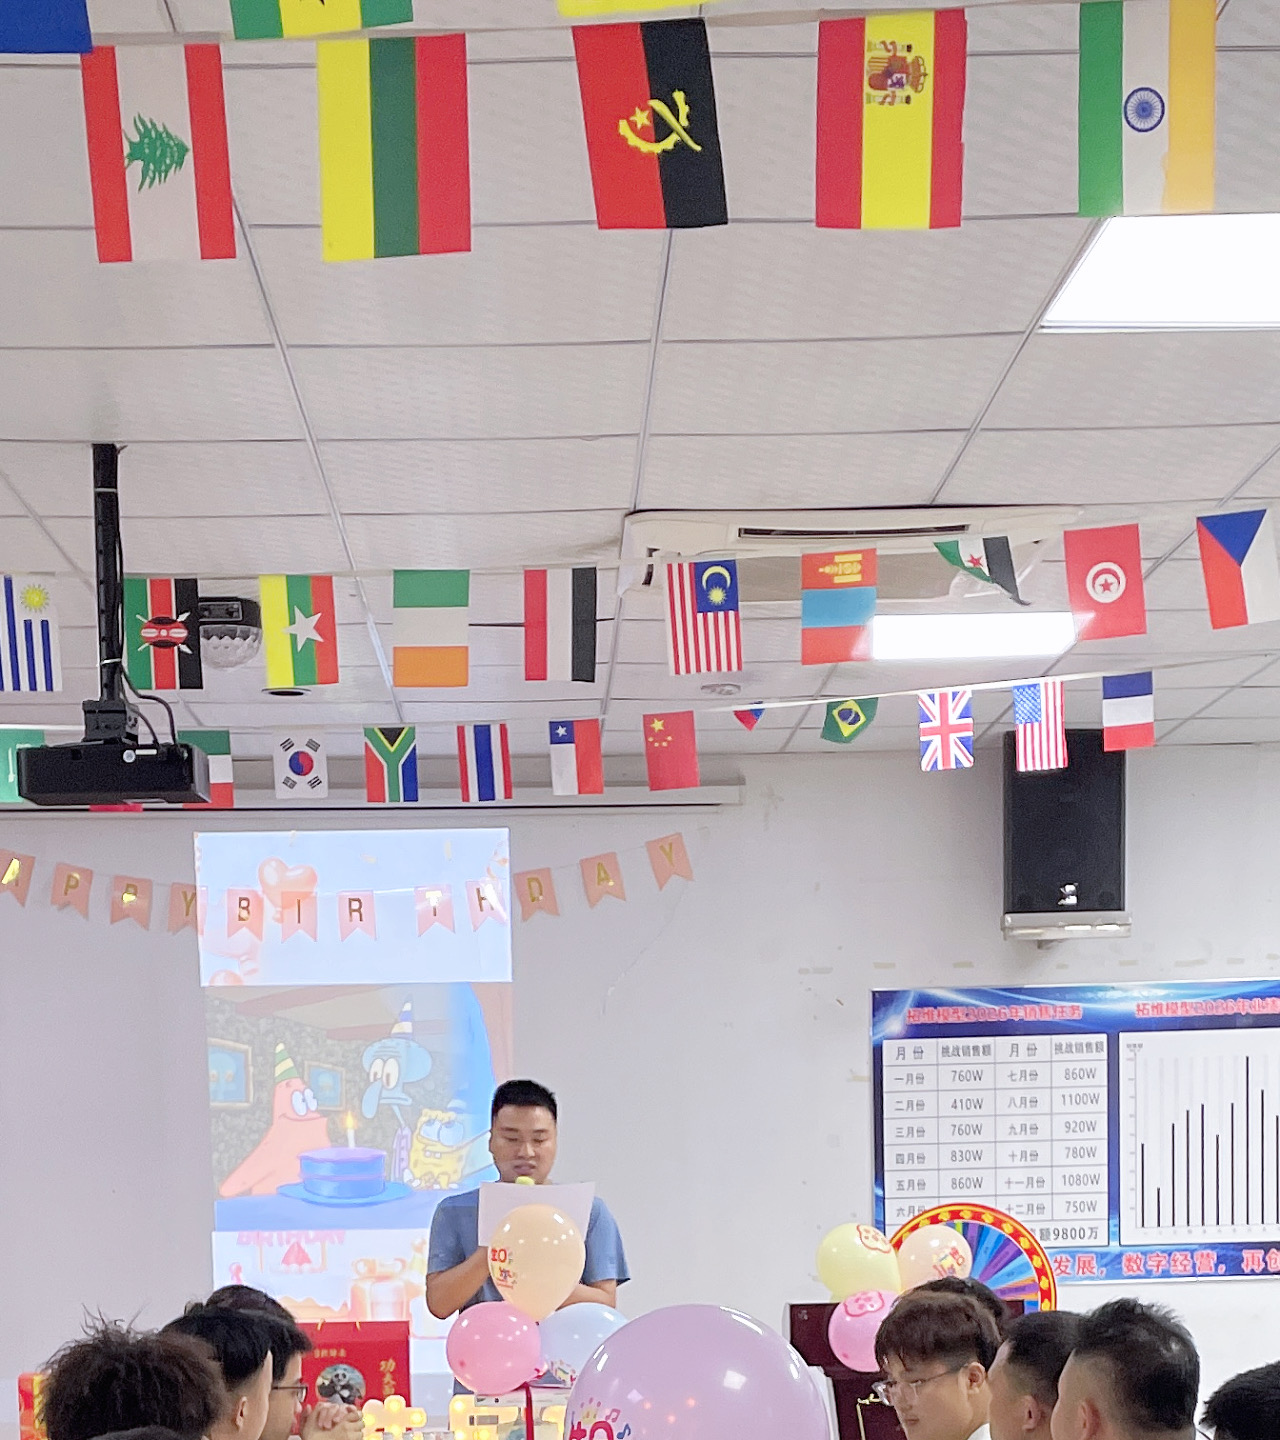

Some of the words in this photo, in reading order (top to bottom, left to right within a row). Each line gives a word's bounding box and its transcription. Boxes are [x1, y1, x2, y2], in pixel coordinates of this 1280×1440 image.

[894, 1073, 925, 1086] 一月份
[951, 1069, 984, 1082] 760W
[1007, 1069, 1039, 1082] 七月份
[1064, 1068, 1097, 1081] 860W
[894, 1099, 926, 1112] 二月份
[951, 1097, 984, 1110] 410W
[1007, 1096, 1039, 1109] 八月份
[1061, 1093, 1100, 1106] 1100W
[895, 1126, 926, 1138] 三月份
[950, 1123, 983, 1136] 760W
[1008, 1123, 1039, 1136] 九月份
[1064, 1120, 1098, 1133] 920W
[895, 1152, 926, 1165] 四月份
[950, 1149, 984, 1162] 830W
[1008, 1149, 1039, 1162] 十月份
[1065, 1146, 1098, 1159] 780W
[896, 1179, 927, 1191] 五月份
[951, 1176, 984, 1189] 860W
[1004, 1176, 1045, 1189] 十一月份
[1062, 1173, 1101, 1186] 1080W
[1065, 1200, 1098, 1213] 750W
